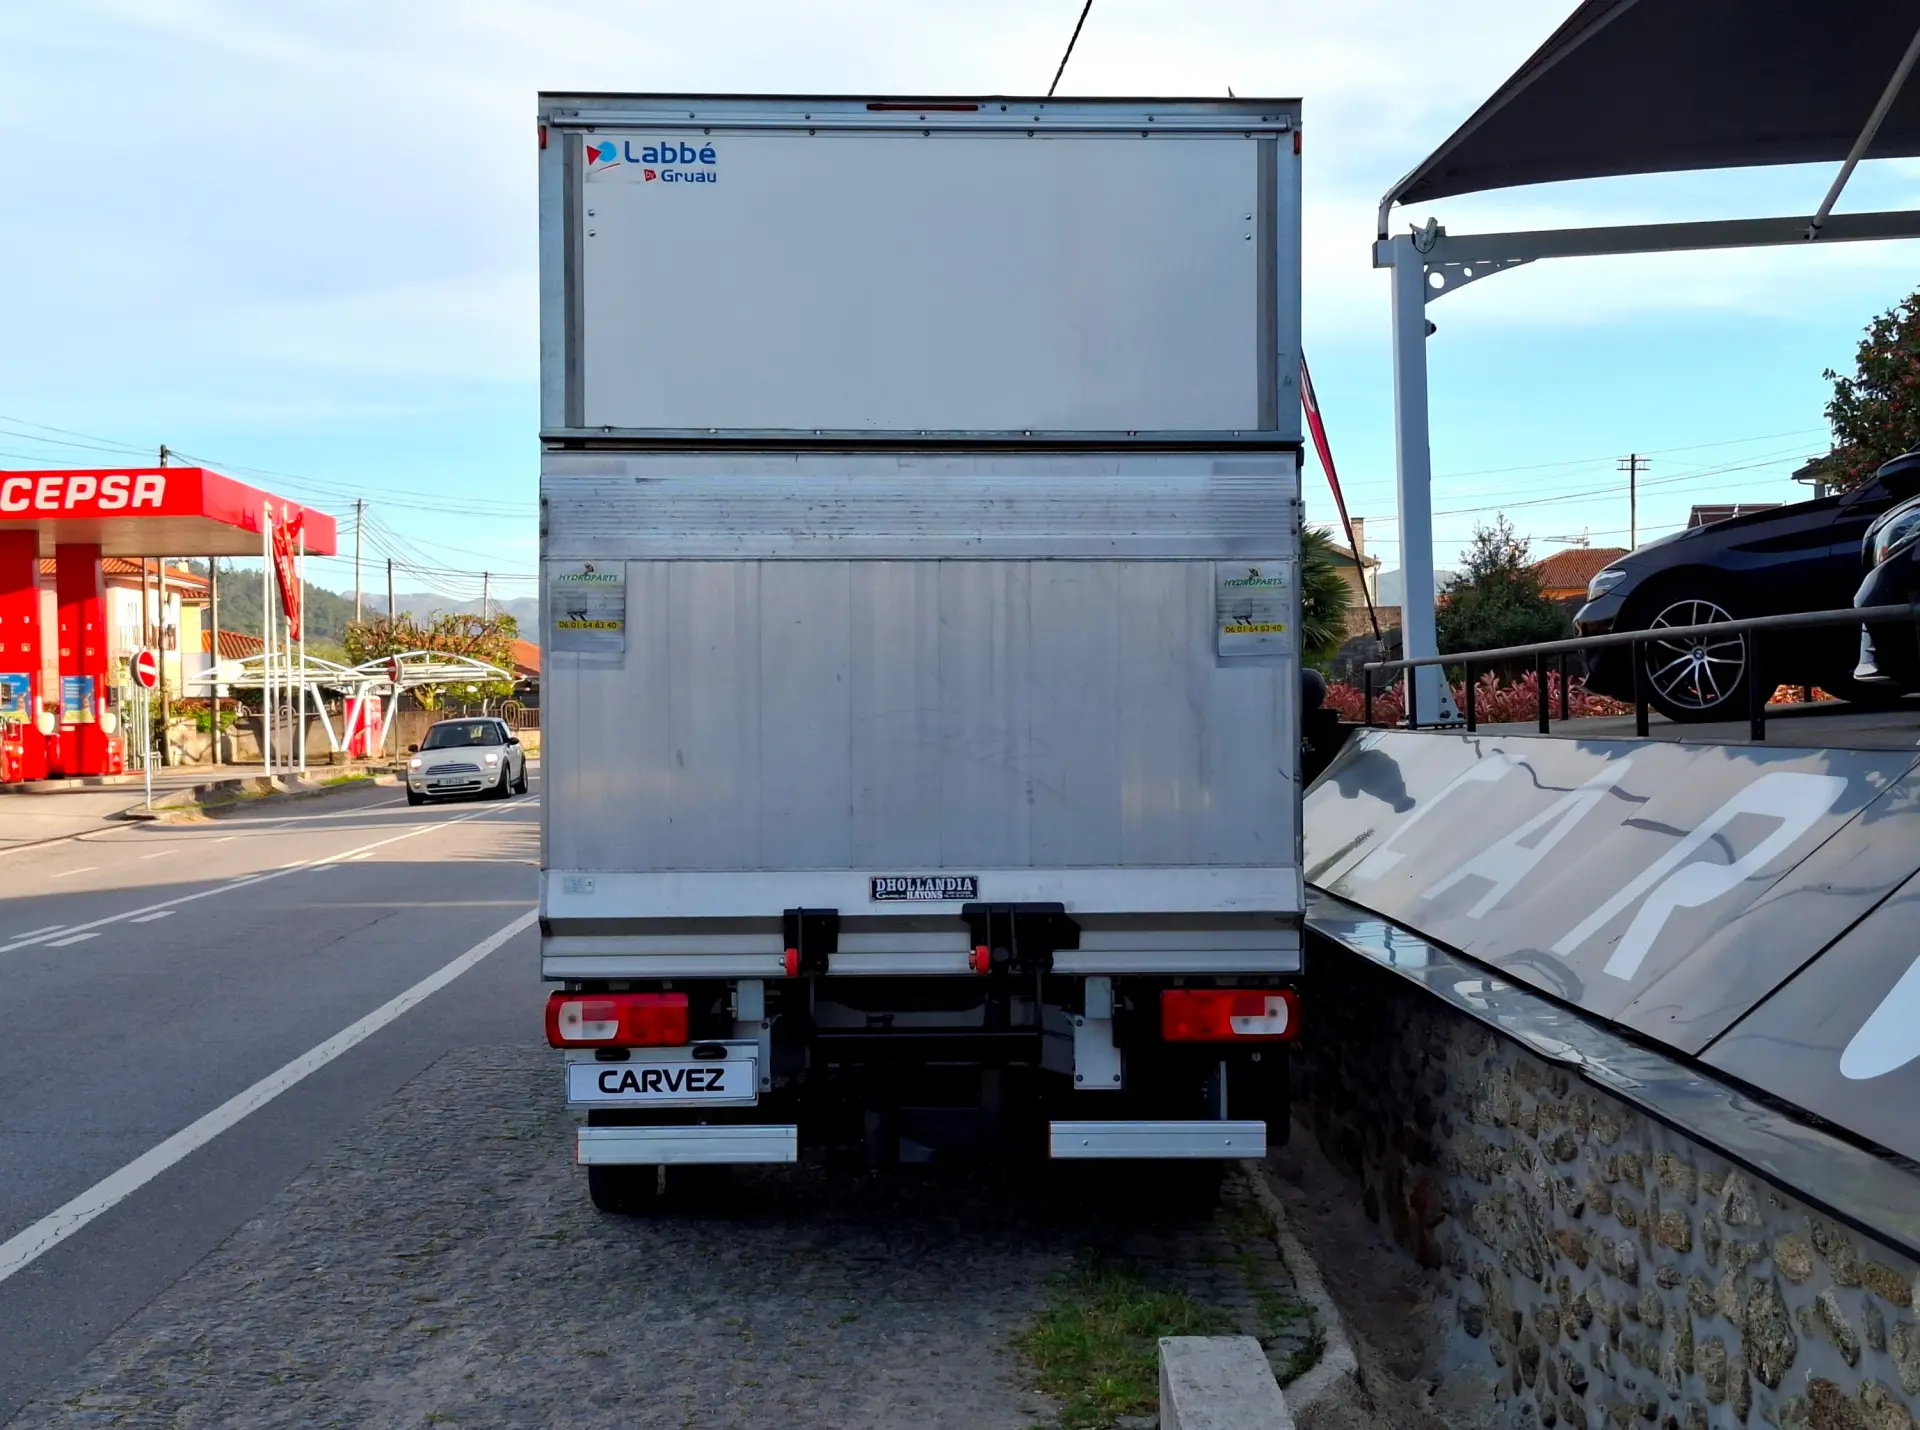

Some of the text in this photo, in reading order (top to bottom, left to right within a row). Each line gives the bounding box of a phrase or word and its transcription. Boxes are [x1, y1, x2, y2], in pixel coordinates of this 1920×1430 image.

[624, 140, 717, 165] Labbé
[661, 169, 717, 183] Gruau
[0, 474, 166, 512] CEPSA
[558, 573, 618, 582] HYDROPARTS
[1224, 578, 1283, 587] HYDROPARTS
[876, 878, 973, 891] DHOLLANDIA
[906, 890, 943, 900] HAYONS
[1353, 752, 1920, 1081] CAR
[598, 1067, 725, 1094] CARVEZ
